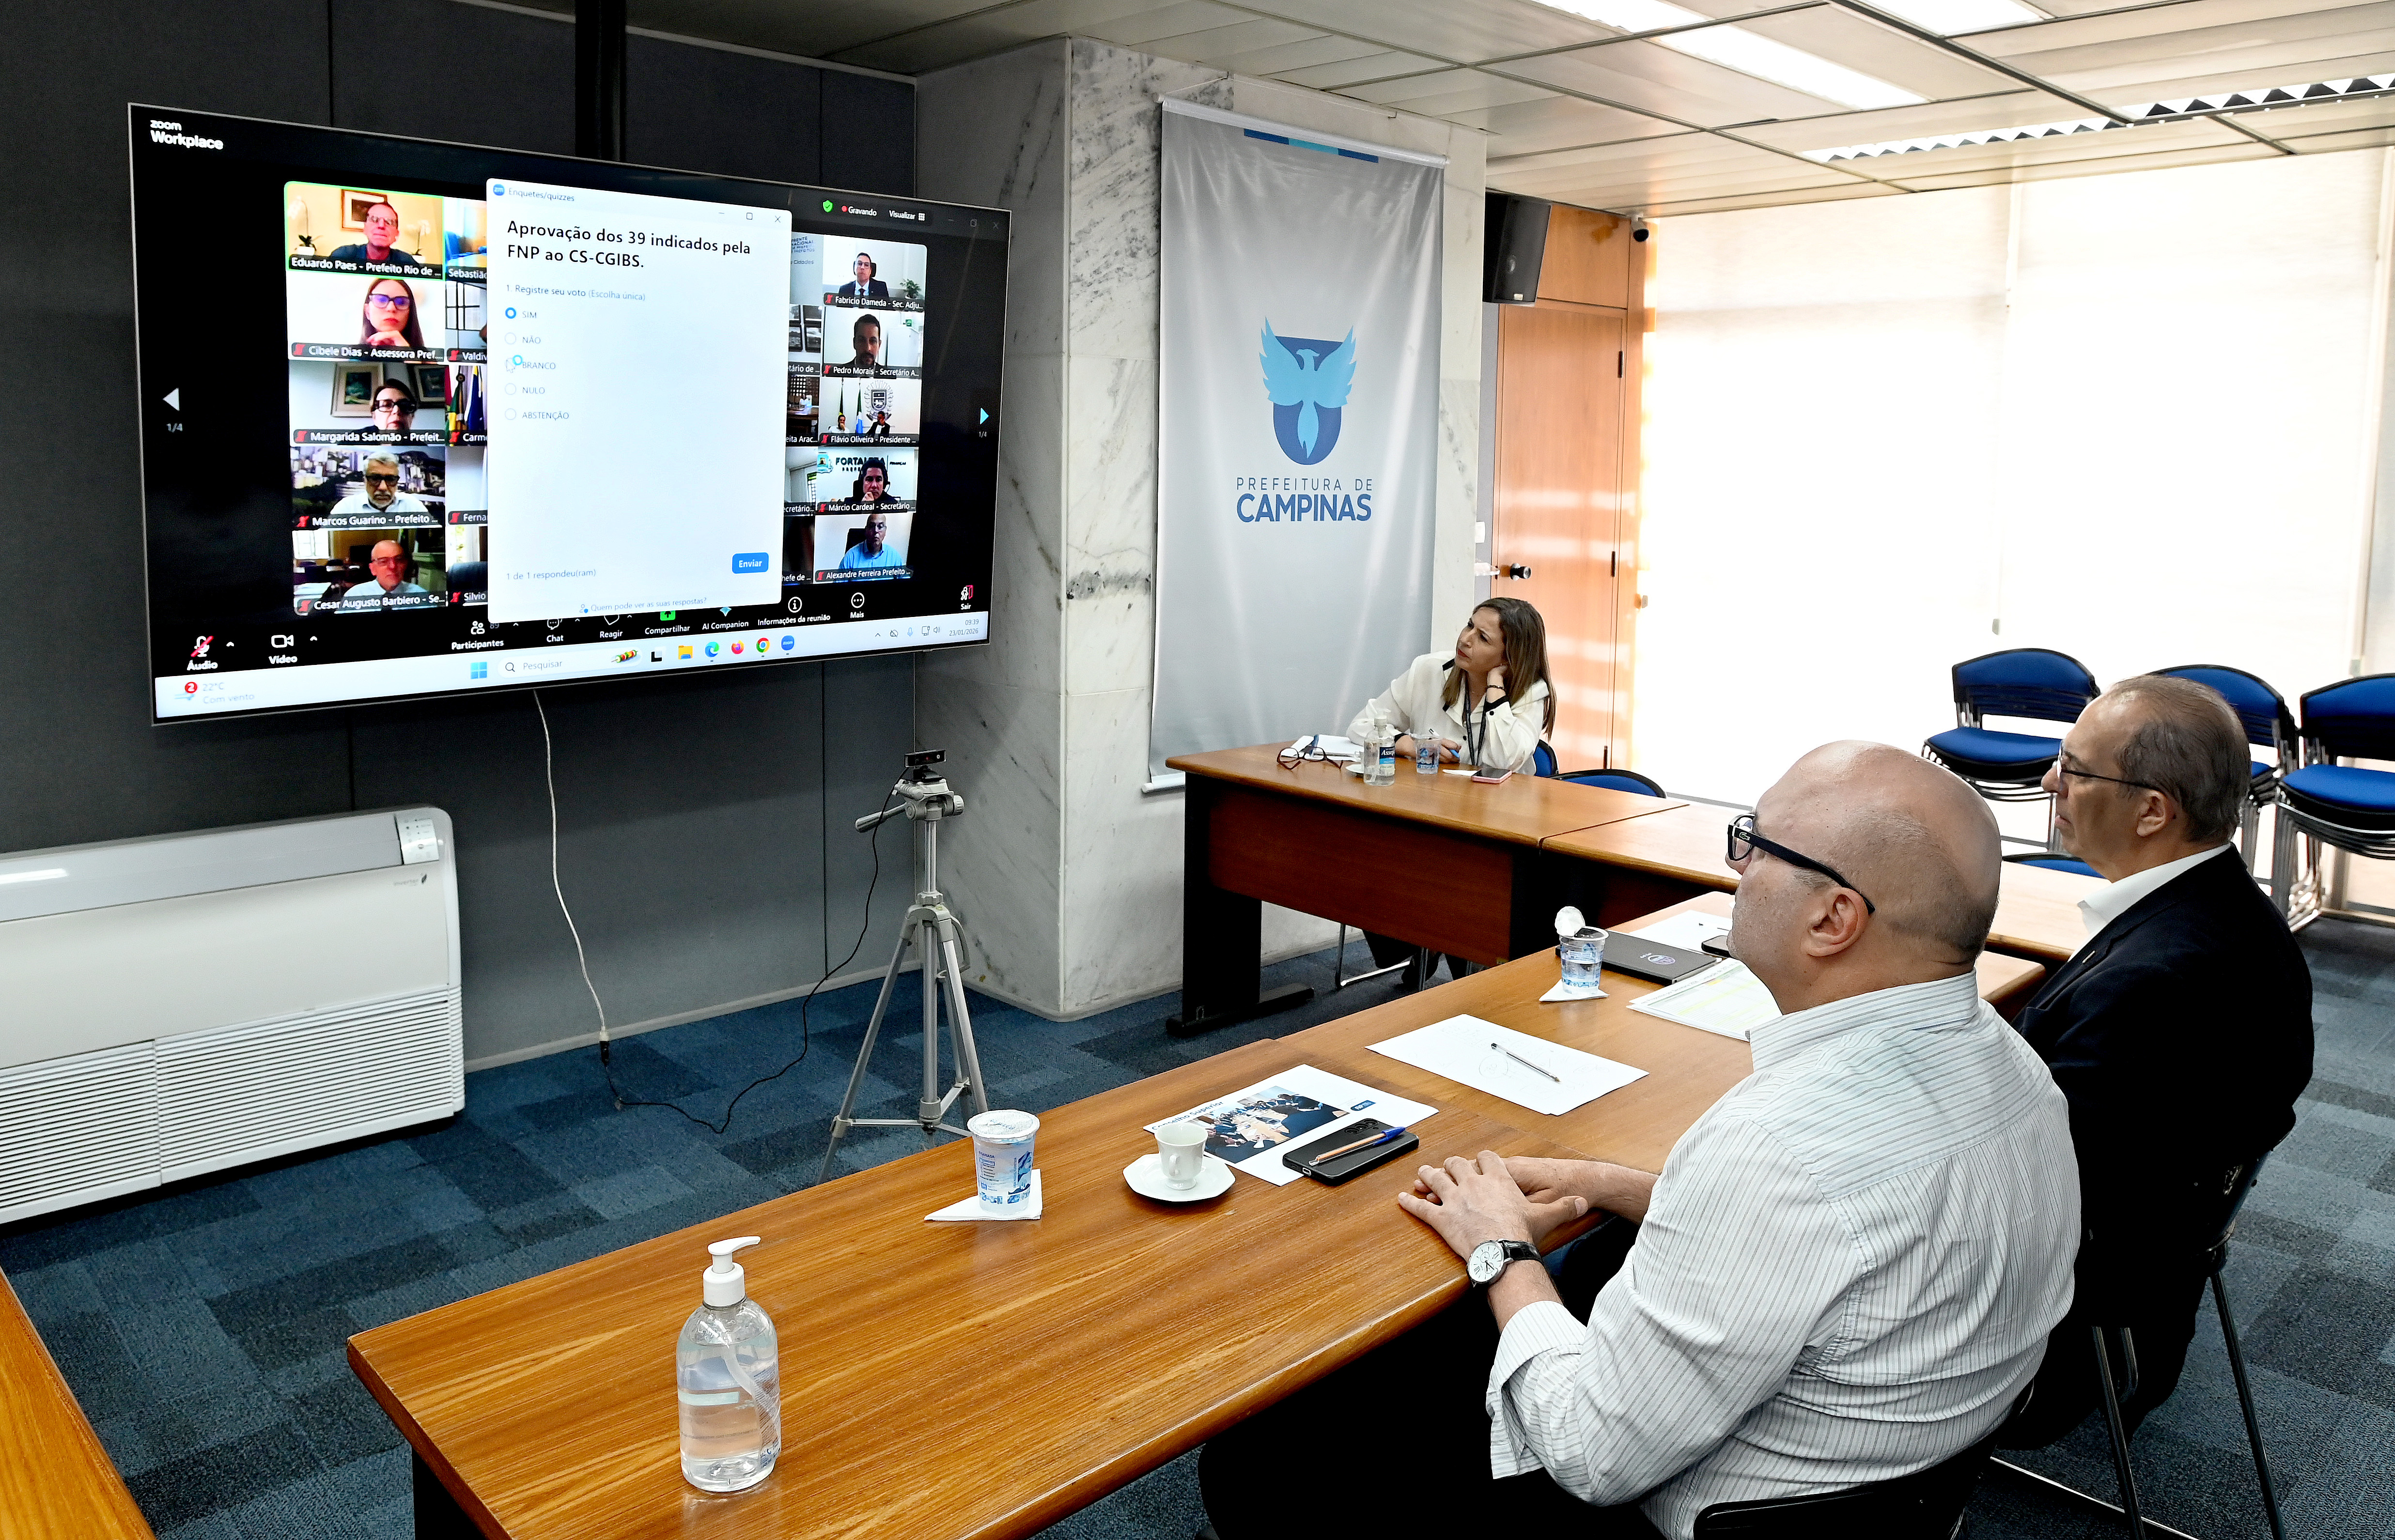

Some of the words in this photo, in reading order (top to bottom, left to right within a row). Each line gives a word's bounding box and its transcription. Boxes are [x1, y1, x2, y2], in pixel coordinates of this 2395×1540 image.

[150, 120, 182, 131] zoom
[150, 130, 223, 150] Workplace
[509, 187, 575, 201] Enquetes/quizzes
[848, 206, 877, 216] Gravando
[889, 210, 916, 220] Visualizar
[507, 220, 591, 242] Aprovação
[596, 229, 623, 243] dos
[628, 231, 646, 245] 39
[651, 233, 718, 251] indicados
[723, 241, 750, 255] pela
[508, 245, 540, 259] FNP
[545, 250, 563, 262] ao
[569, 250, 644, 268] CS-CGIBS.
[292, 258, 333, 269] Eduardo
[335, 261, 357, 271] Paes
[366, 262, 402, 274] Prefeito
[404, 265, 419, 275] Rio
[420, 266, 432, 276] de
[515, 285, 549, 295] Registre
[589, 290, 620, 299] (Escolha
[622, 292, 646, 301] única)
[835, 296, 860, 305] Fabricio
[861, 298, 886, 307] Dameda
[523, 336, 541, 344] NÃO
[309, 345, 339, 356] Cibele
[341, 347, 362, 356] Dias
[371, 348, 415, 358] Assessora
[853, 367, 874, 375] Morais
[879, 368, 909, 376] Secretário
[522, 411, 569, 421] ABSTENÇÃO
[166, 423, 183, 432] 1/4
[311, 432, 360, 443] Margarida
[362, 432, 401, 442] Salomão
[831, 434, 849, 443] Flávio
[850, 434, 874, 443] Oliveira
[836, 457, 885, 465] FORTAA
[1237, 477, 1341, 491] PREFEITURA
[1355, 478, 1372, 491] DE
[828, 503, 850, 511] Márcio
[851, 503, 874, 511] Cardeal
[880, 502, 910, 510] Secretário
[1236, 493, 1371, 523] CAMPINAS
[312, 517, 347, 526] Marcos
[349, 515, 386, 525] Guarino
[395, 515, 430, 524] Prefeito
[738, 558, 762, 569] Enviar
[533, 570, 596, 580] respondeu(ram)
[826, 570, 857, 580] Alexandre
[858, 569, 881, 578] Ferreira
[882, 568, 905, 577] Prefeito
[464, 592, 485, 601] Silvio
[314, 601, 339, 610] Cesar
[342, 598, 382, 610] Augusto
[383, 596, 420, 606] Barbiero
[614, 602, 632, 611] pode
[672, 597, 707, 606] respostas?
[711, 621, 749, 630] Companion
[758, 618, 796, 626] Informações
[600, 630, 623, 639] Reagir
[645, 625, 690, 635] Compartilhar
[949, 628, 979, 636] 23/01/2026
[451, 638, 504, 650] Participantes
[269, 654, 297, 664] Vídeo
[523, 658, 562, 671] Pesquisar
[187, 660, 218, 671] Áudio
[188, 683, 195, 692] 2
[202, 682, 224, 692] 22°C
[1190, 1101, 1224, 1116] Superior
